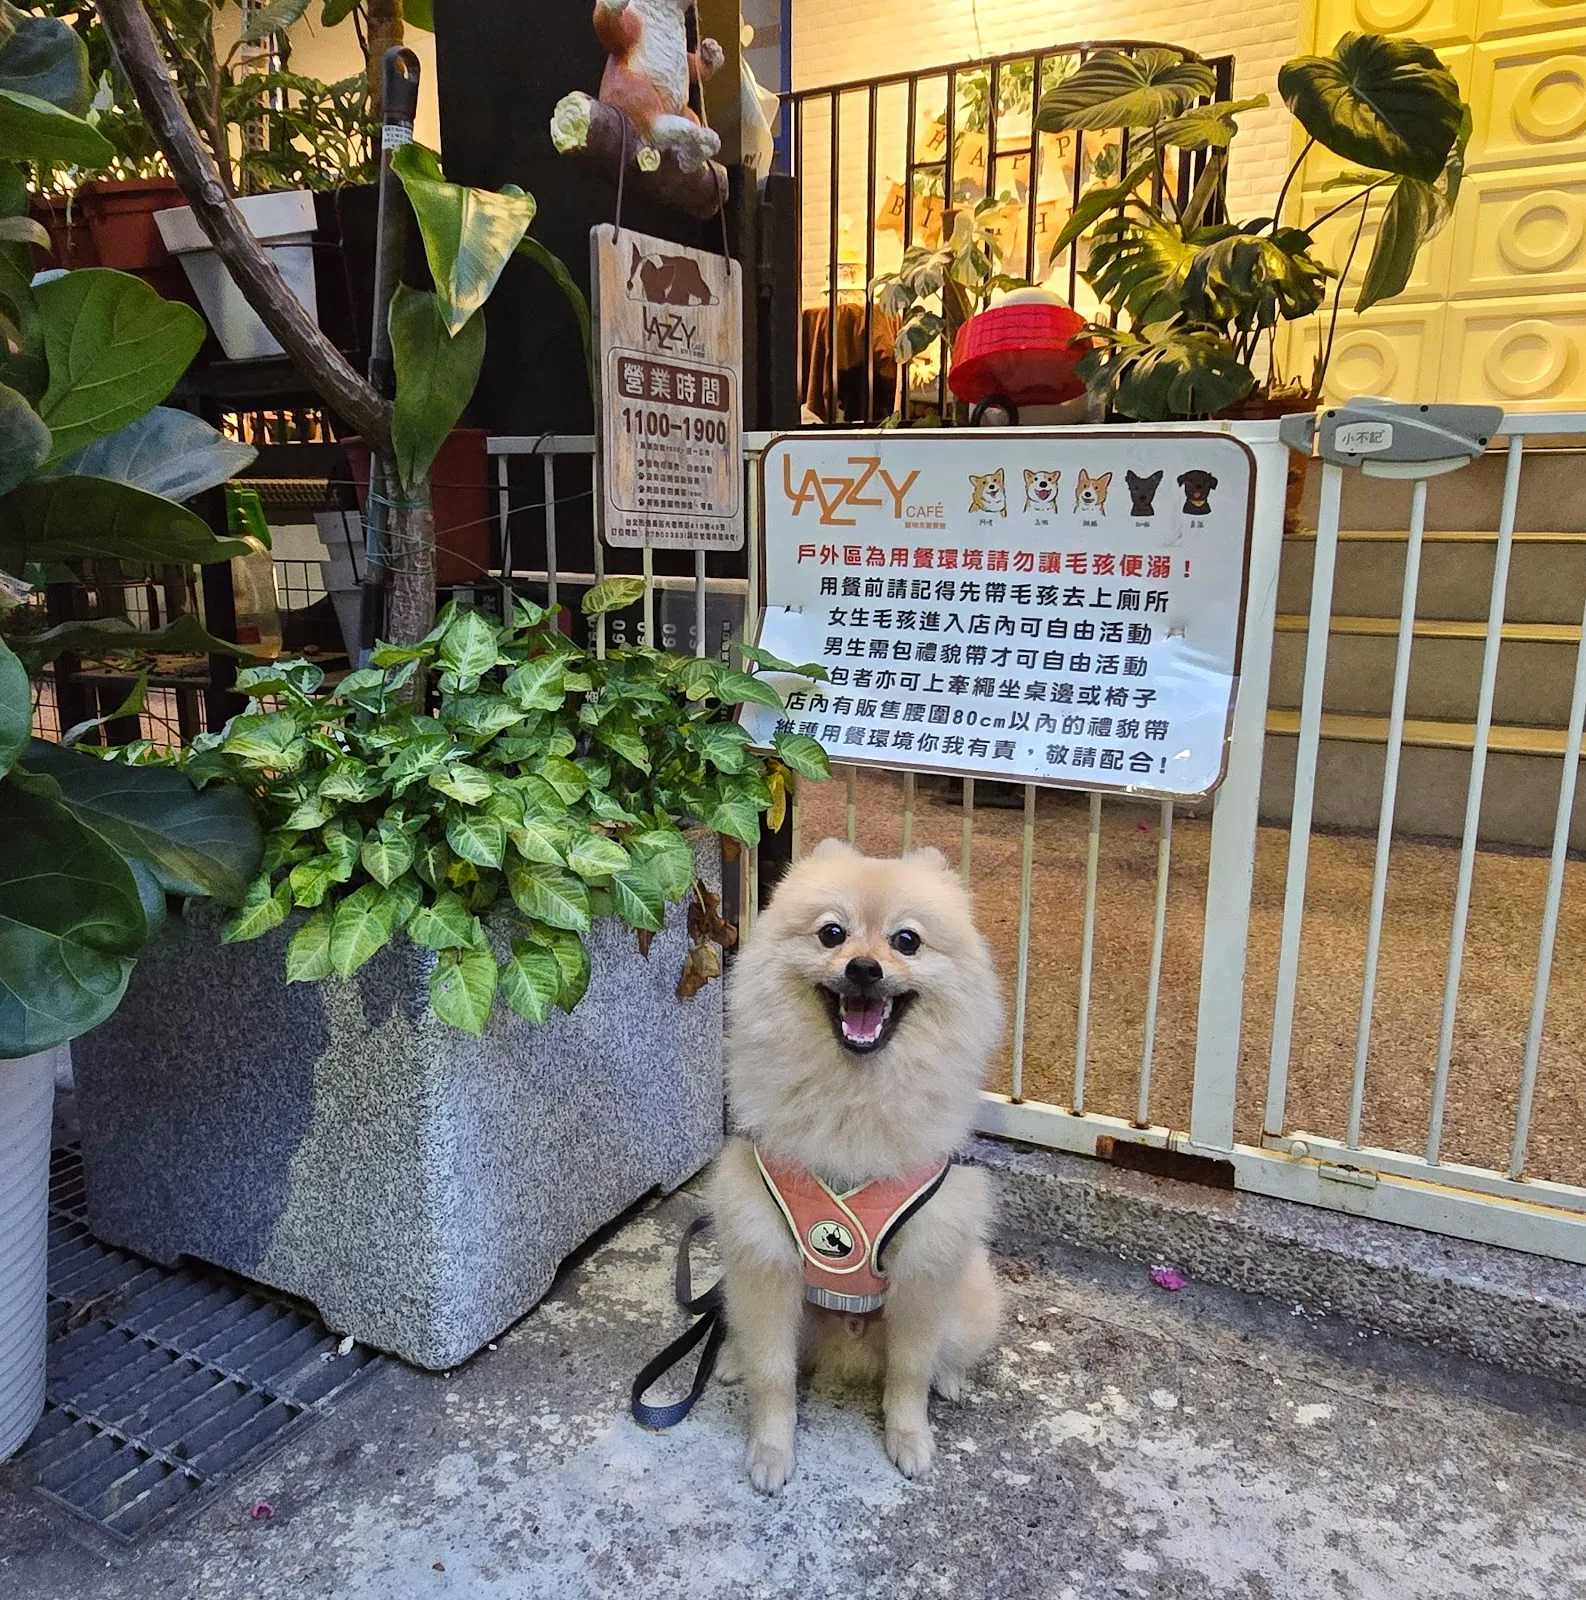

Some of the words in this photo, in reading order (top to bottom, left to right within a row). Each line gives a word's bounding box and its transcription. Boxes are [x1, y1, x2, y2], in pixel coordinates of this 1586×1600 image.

[642, 306, 697, 350] LAZZY
[623, 362, 721, 407] 營業時間
[622, 407, 727, 445] 1100-1900
[1341, 429, 1386, 445] 小不記
[783, 453, 922, 526] LAZZY
[905, 501, 945, 518] CAFÉ
[819, 576, 1169, 613] 用餐前請記得先帶毛孩去上廁所
[828, 607, 1152, 645] 女生毛孩進入店內可自由活動
[823, 636, 1148, 677] 男生需包禮貌帶才可自由活動
[807, 666, 1157, 708] 包者亦可上牽繩坐桌邊或椅子
